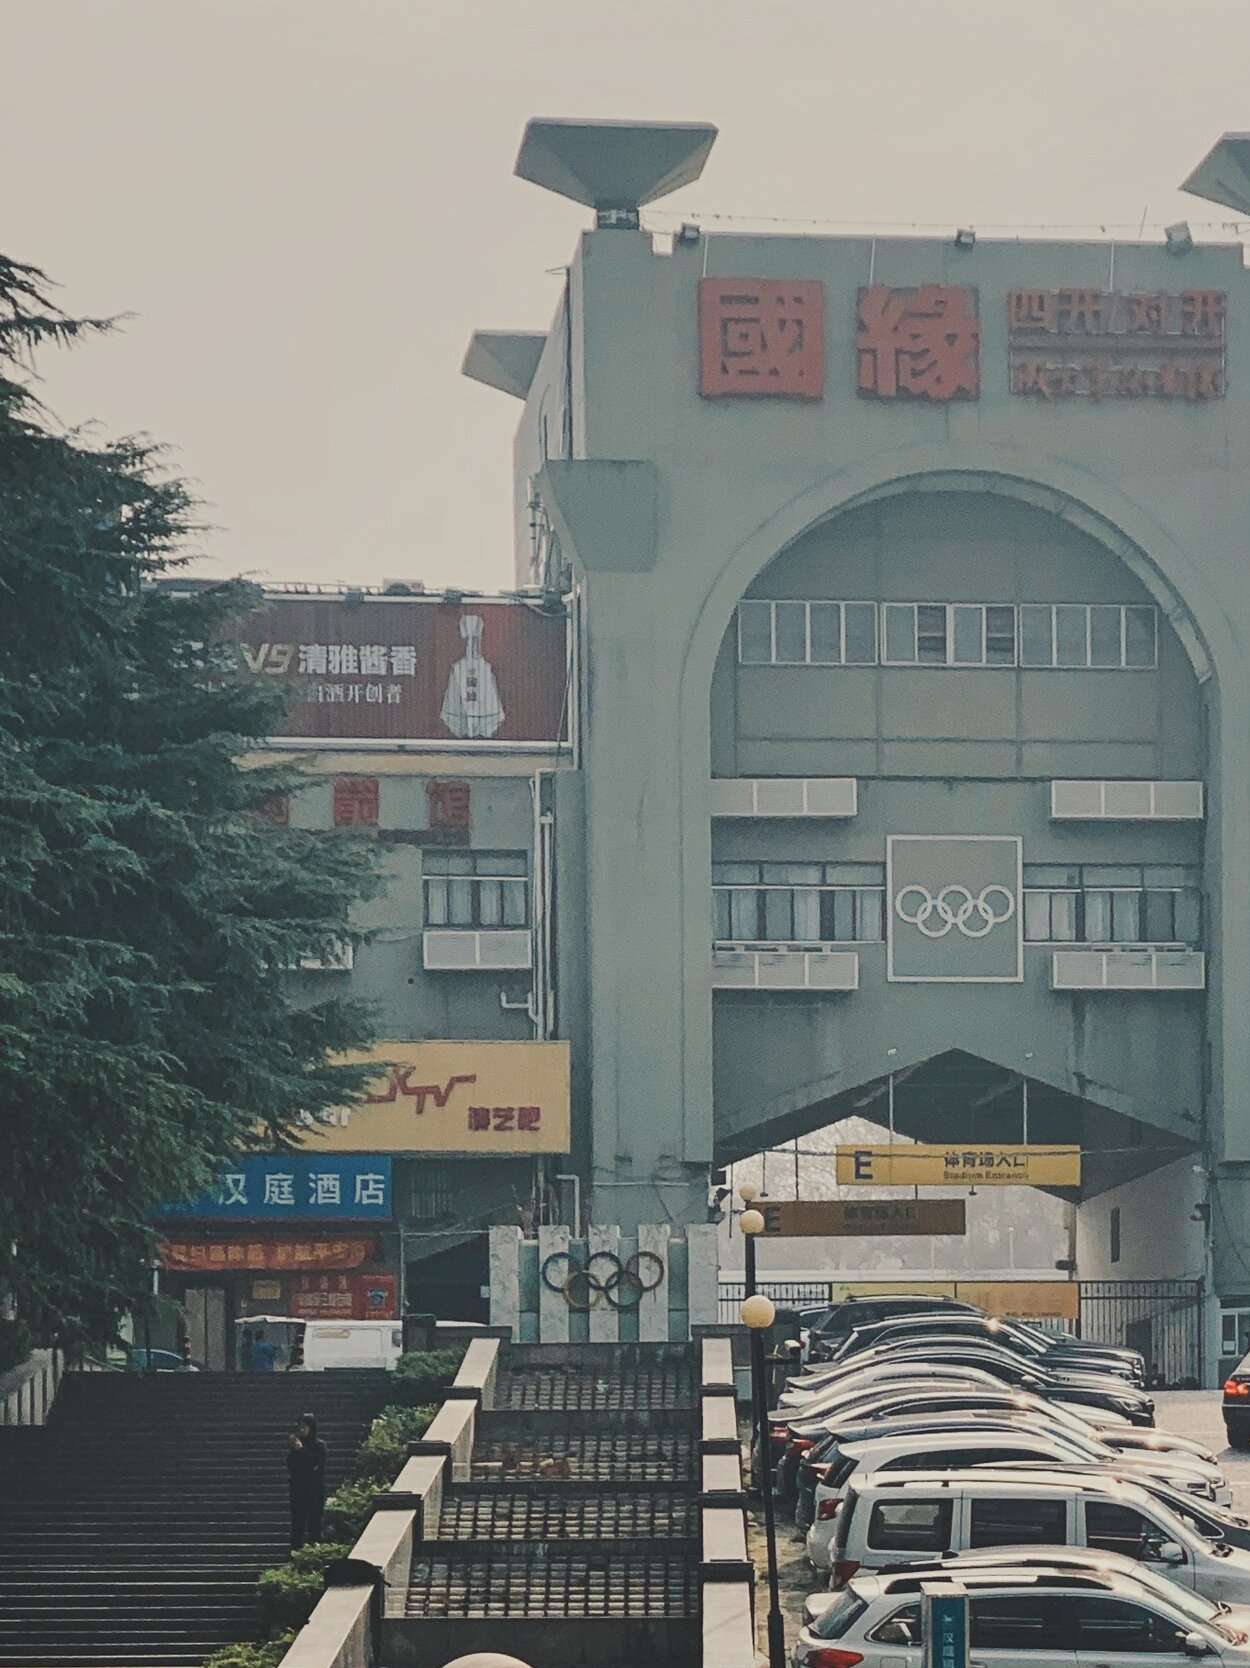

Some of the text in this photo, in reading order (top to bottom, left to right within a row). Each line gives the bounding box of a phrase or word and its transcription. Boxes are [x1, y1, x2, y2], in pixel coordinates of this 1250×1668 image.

[855, 1151, 873, 1180] E
[944, 1151, 1029, 1168] 体育场入口
[218, 1173, 386, 1206] 汉庭酒店
